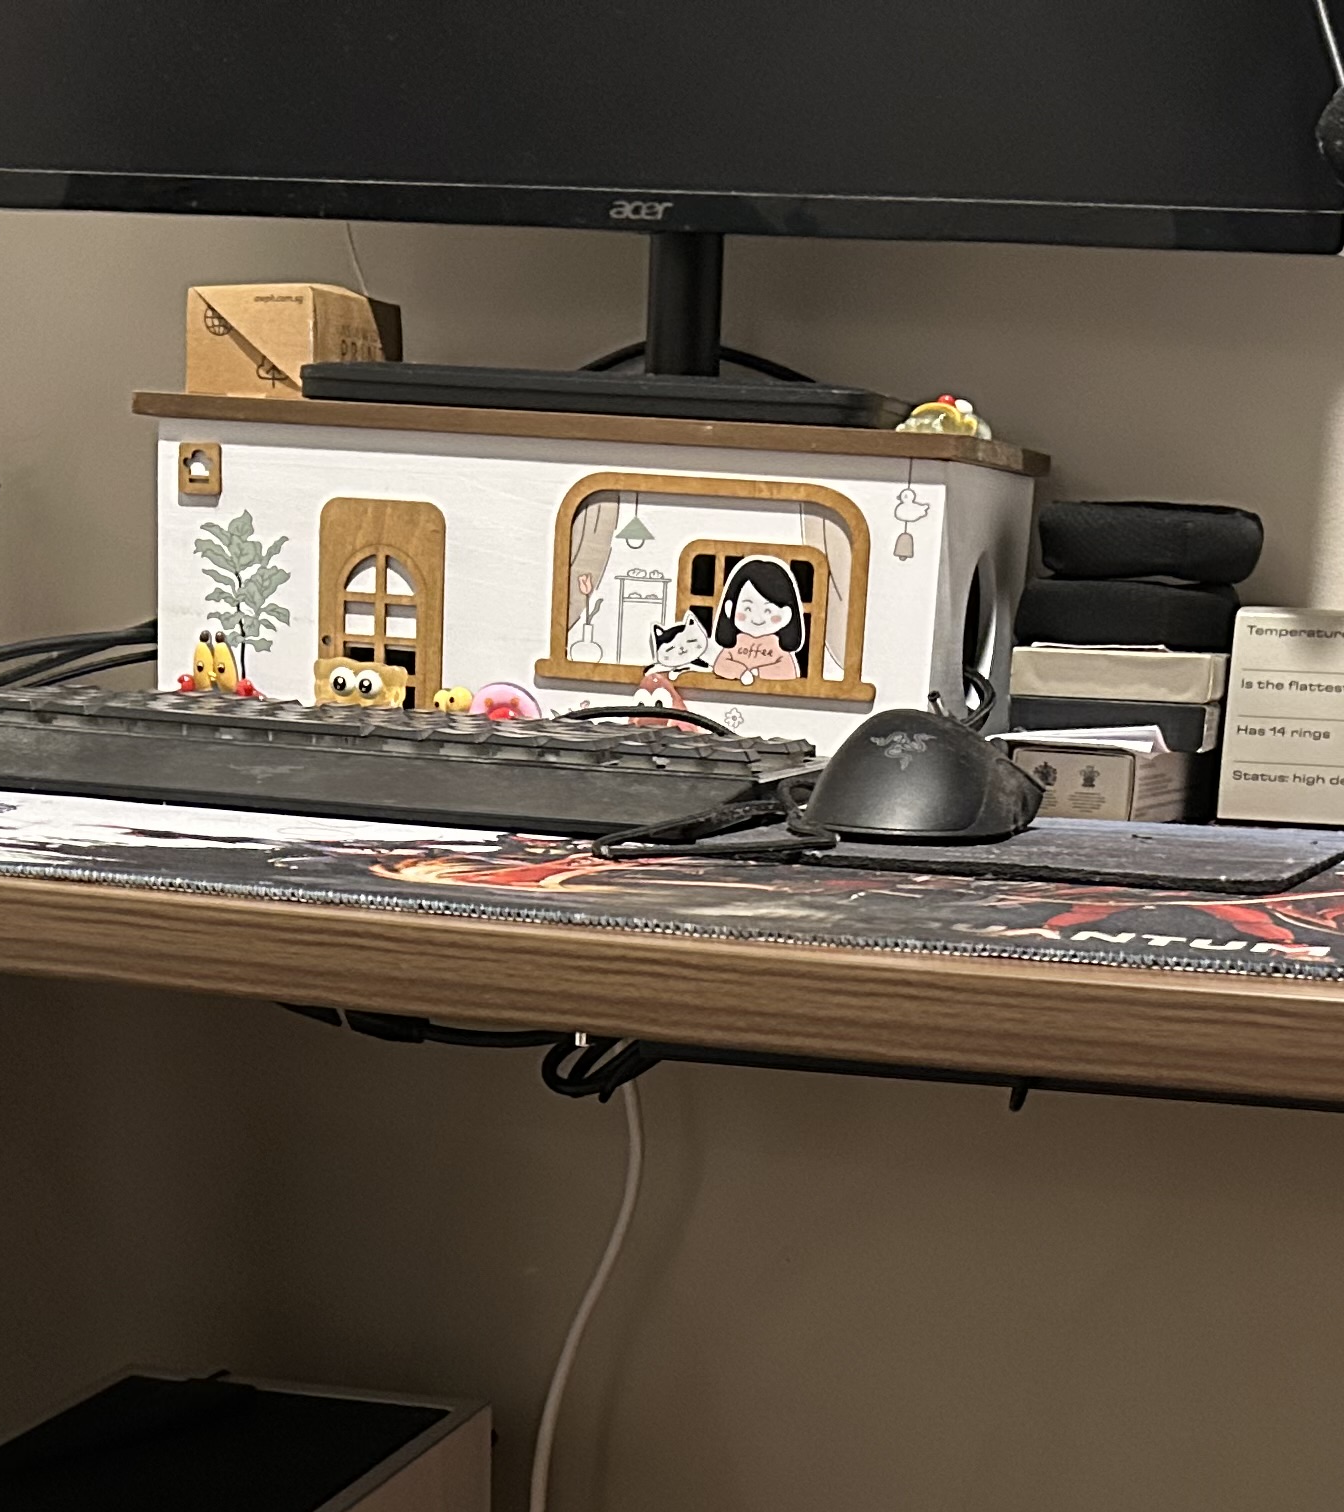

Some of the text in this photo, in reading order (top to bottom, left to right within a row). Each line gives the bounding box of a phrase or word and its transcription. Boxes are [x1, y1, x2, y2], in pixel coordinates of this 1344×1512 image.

[609, 200, 673, 220] acer
[737, 643, 773, 659] coffee
[1240, 679, 1253, 689] Is
[1257, 680, 1284, 691] the
[1237, 725, 1331, 741] Has 14 rings
[1232, 770, 1289, 783] Status:
[1292, 773, 1326, 786] high
[901, 919, 1332, 957] UANTUM
